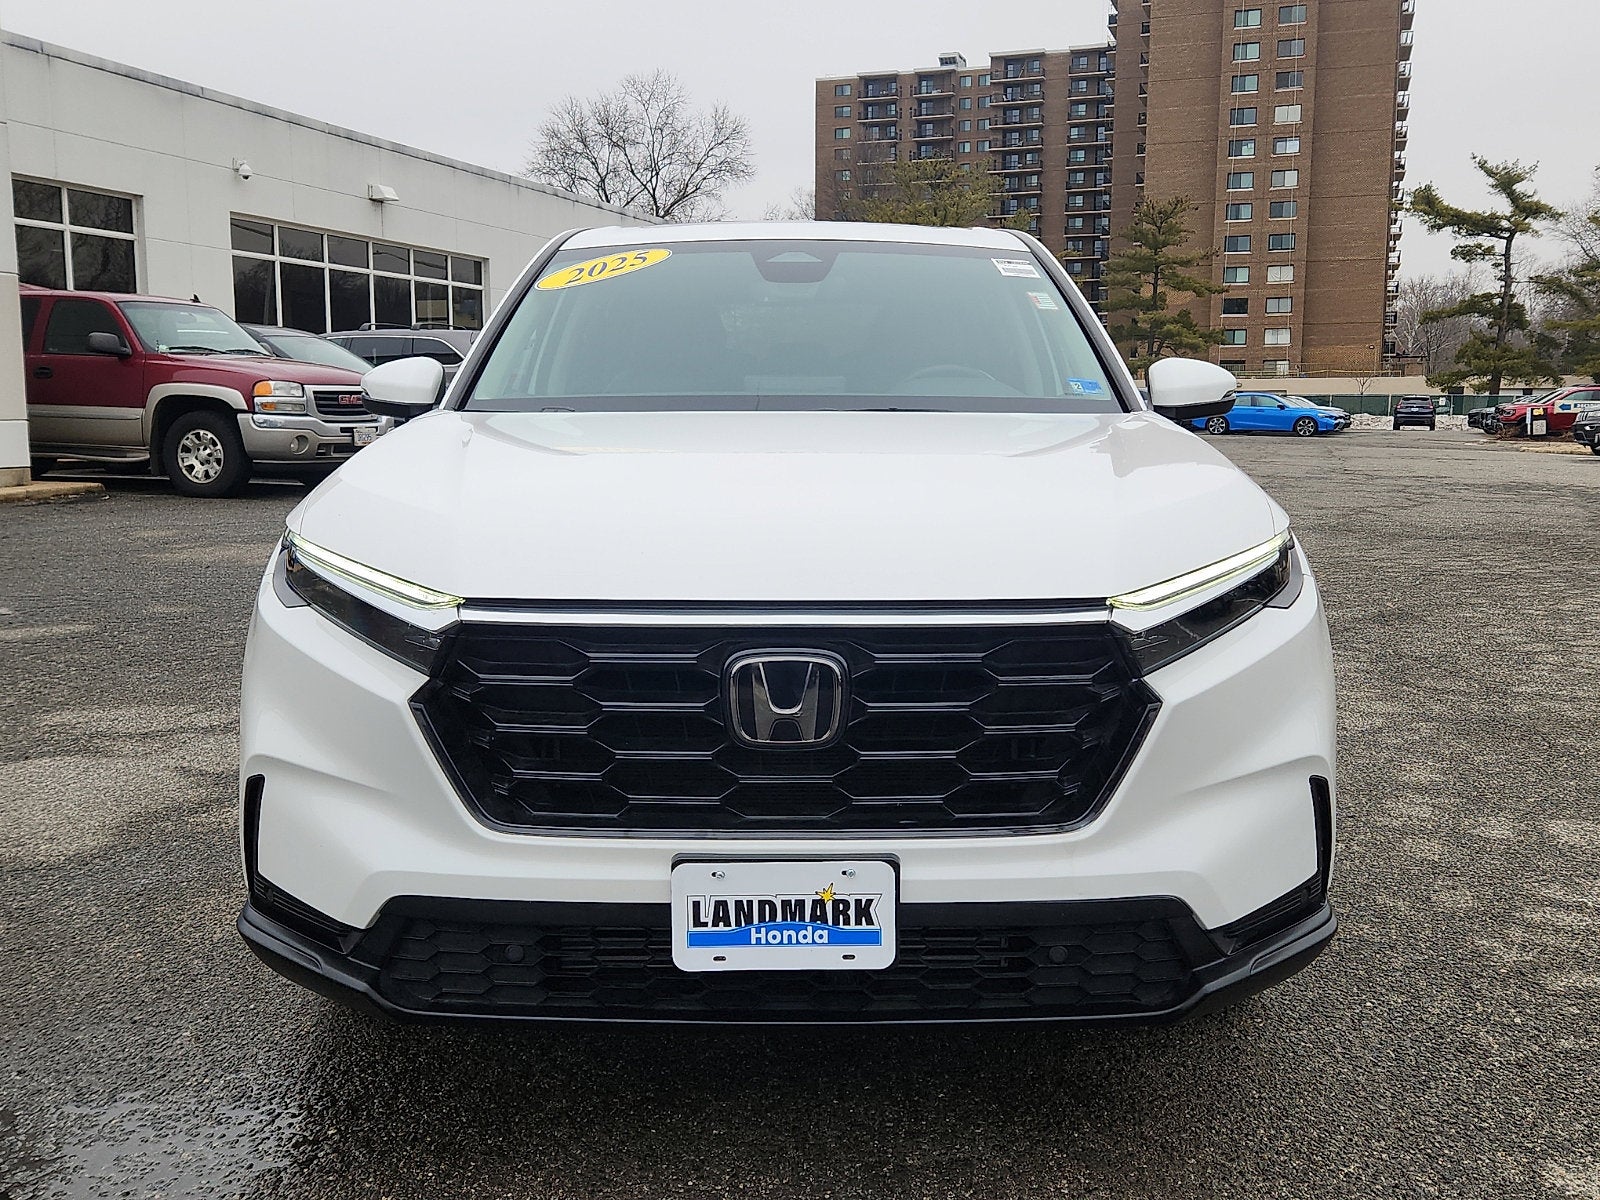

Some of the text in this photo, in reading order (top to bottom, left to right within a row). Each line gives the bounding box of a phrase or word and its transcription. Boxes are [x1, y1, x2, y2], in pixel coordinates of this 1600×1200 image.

[564, 250, 650, 285] 2025
[691, 897, 876, 928] LANDMARK
[750, 927, 829, 945] Honda
